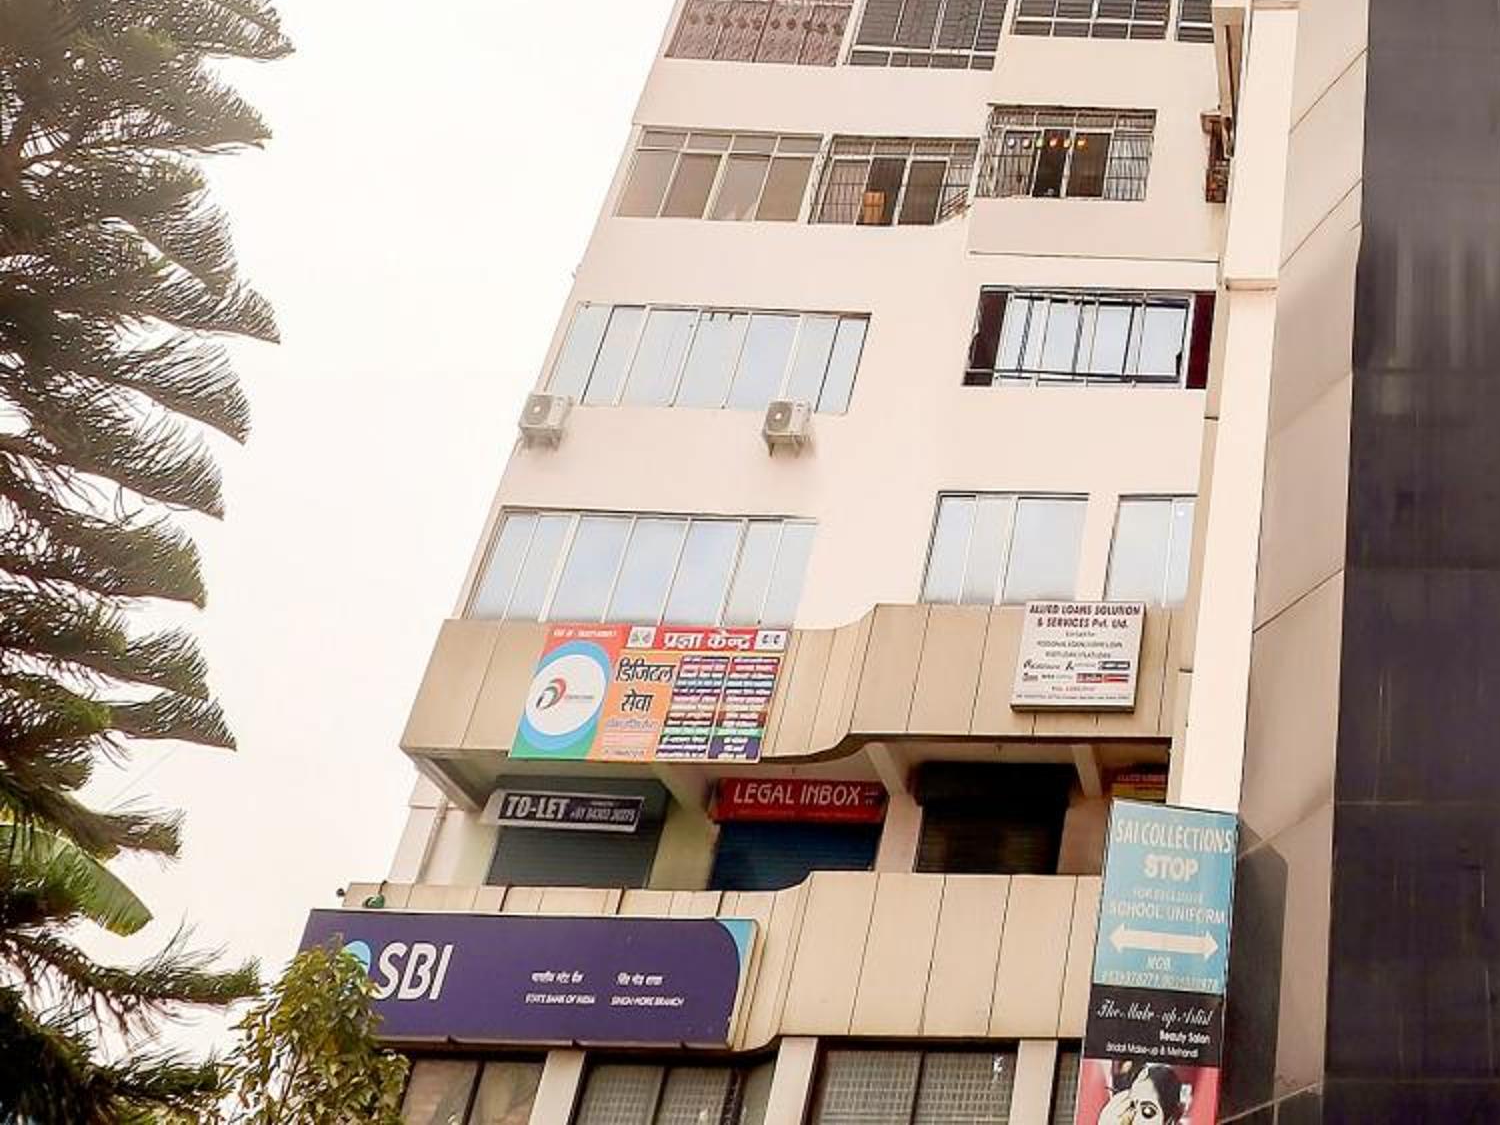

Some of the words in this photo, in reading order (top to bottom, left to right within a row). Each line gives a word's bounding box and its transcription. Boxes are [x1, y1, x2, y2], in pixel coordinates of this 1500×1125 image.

[1029, 604, 1060, 615] ALLIED
[1061, 605, 1092, 616] LOANS
[1094, 605, 1141, 616] SOLUTION
[1046, 617, 1090, 628] SERVICES
[615, 656, 677, 682] डिजिटल
[621, 688, 655, 713] सेवा
[733, 782, 796, 805] LEGAL
[800, 783, 862, 806] INBOX
[504, 795, 571, 820] TO-LET
[1115, 818, 1138, 845] SAI
[1141, 821, 1233, 854] COLLECTIONS
[1143, 854, 1200, 882] STOP
[1109, 899, 1164, 920] SCHOOL
[1166, 904, 1226, 925] UNIFORM
[371, 941, 454, 1001] SBI
[1159, 1029, 1187, 1045] Beauty
[1188, 1032, 1211, 1044] Salon
